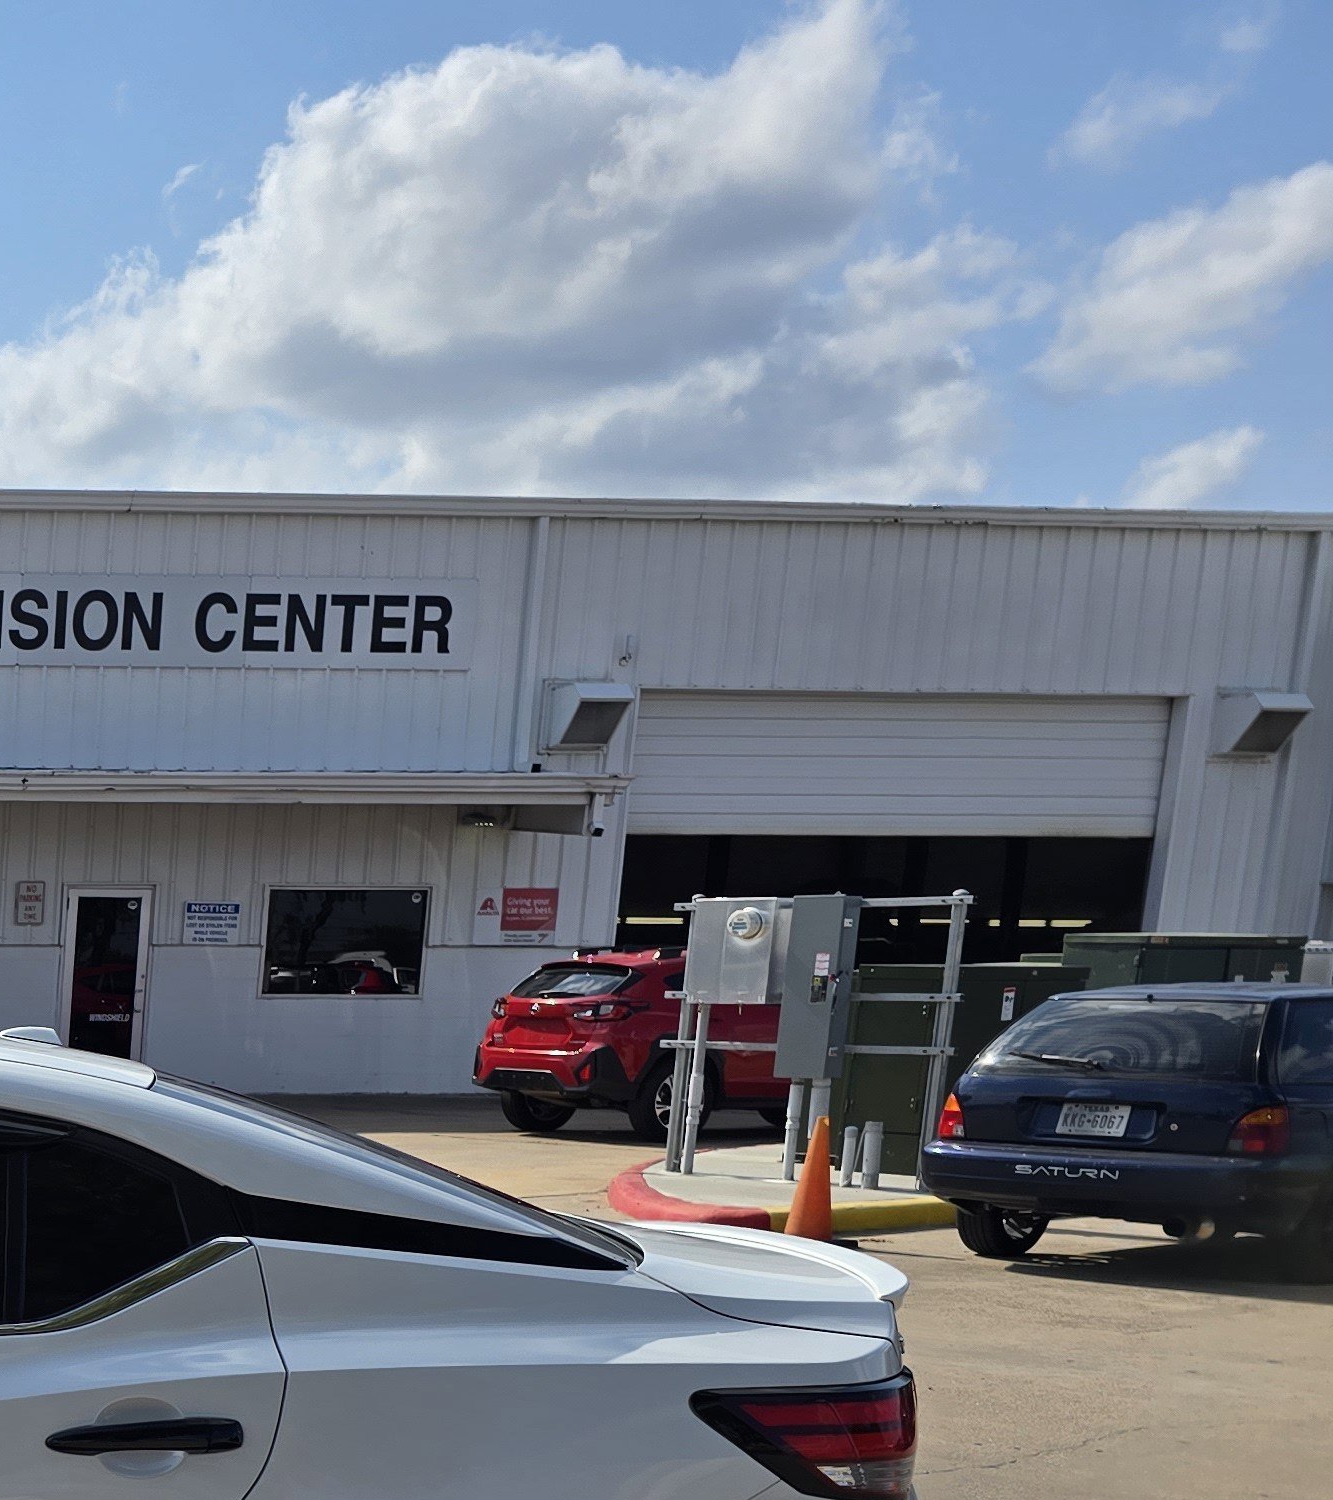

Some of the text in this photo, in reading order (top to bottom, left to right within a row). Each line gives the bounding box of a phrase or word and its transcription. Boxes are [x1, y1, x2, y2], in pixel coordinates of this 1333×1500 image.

[195, 592, 453, 653] CENTER
[26, 884, 37, 893] NO
[19, 894, 42, 902] PARKING
[507, 897, 550, 908] Giving your
[191, 904, 235, 913] NOTICE
[1084, 1105, 1111, 1113] TEXAS
[1014, 1164, 1120, 1180] SATURN
